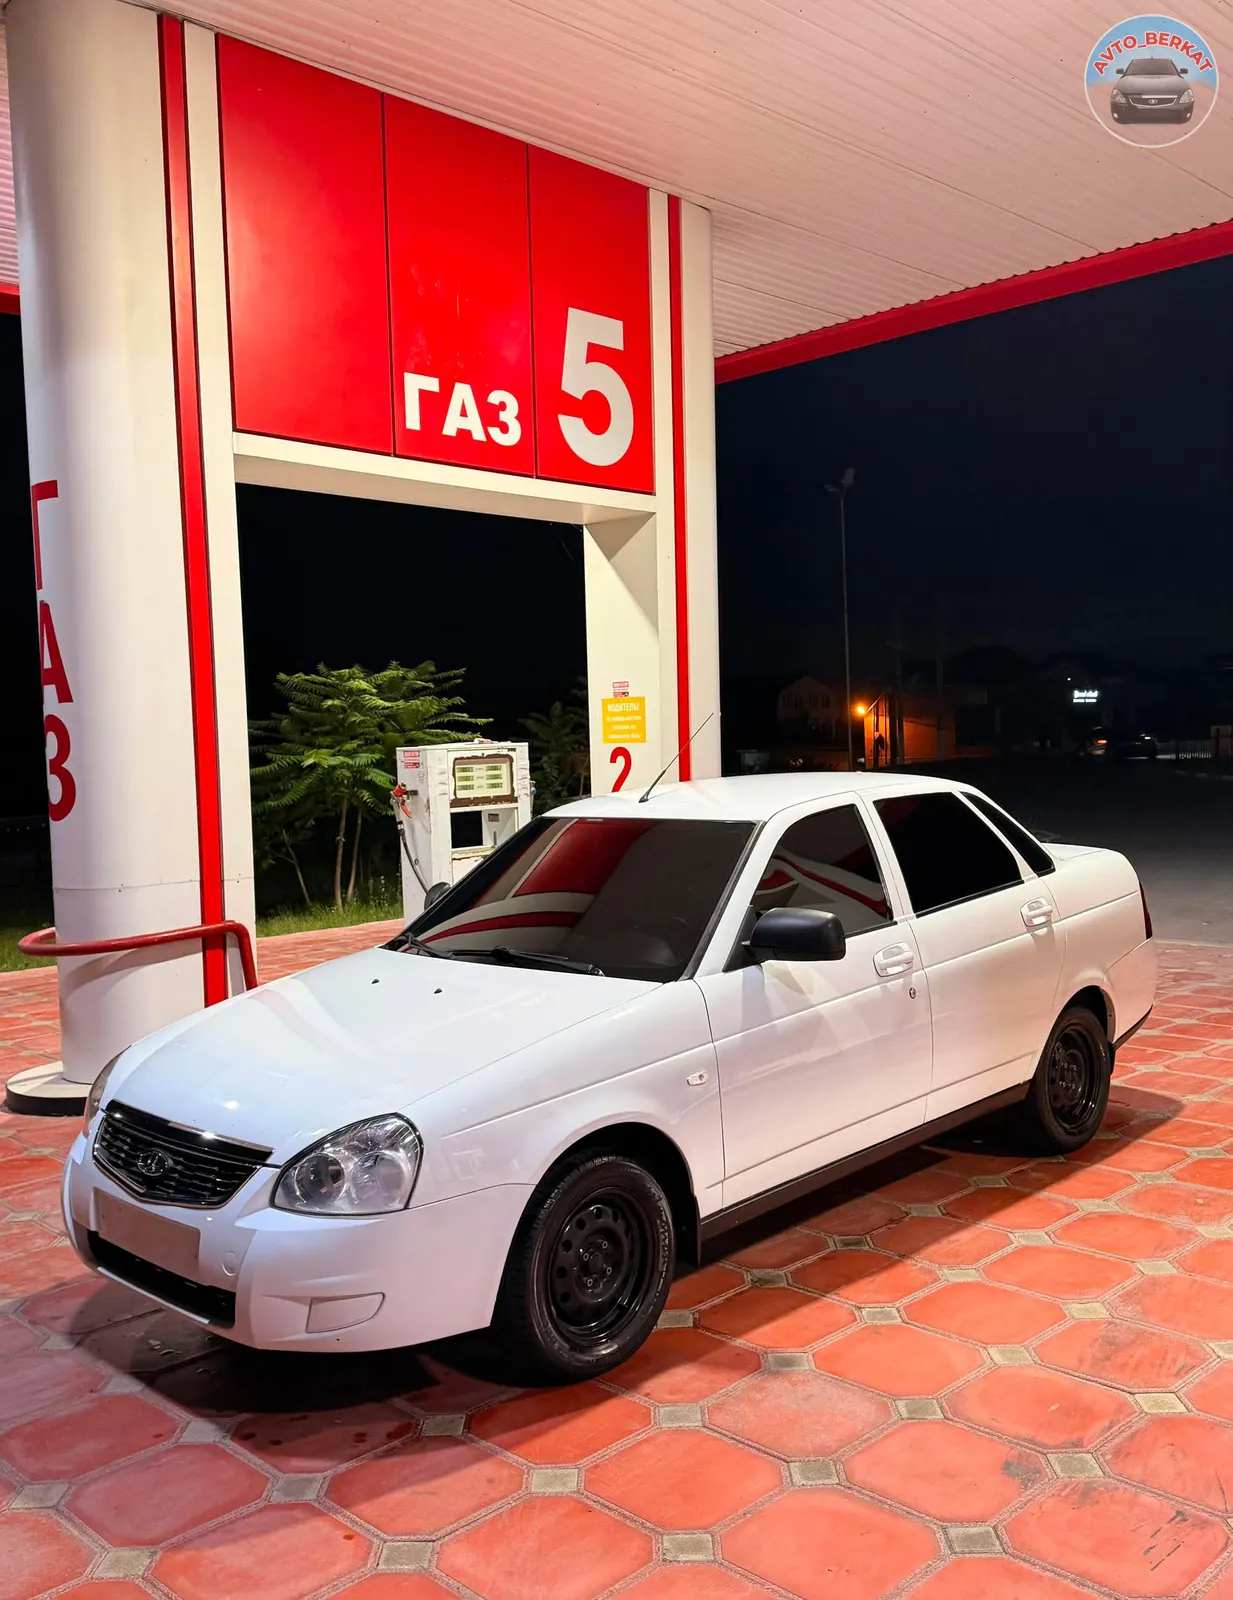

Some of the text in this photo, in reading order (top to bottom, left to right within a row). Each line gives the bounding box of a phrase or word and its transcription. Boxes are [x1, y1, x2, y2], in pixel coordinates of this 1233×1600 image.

[403, 306, 635, 467] ГАЗ 5
[609, 746, 632, 793] 2
